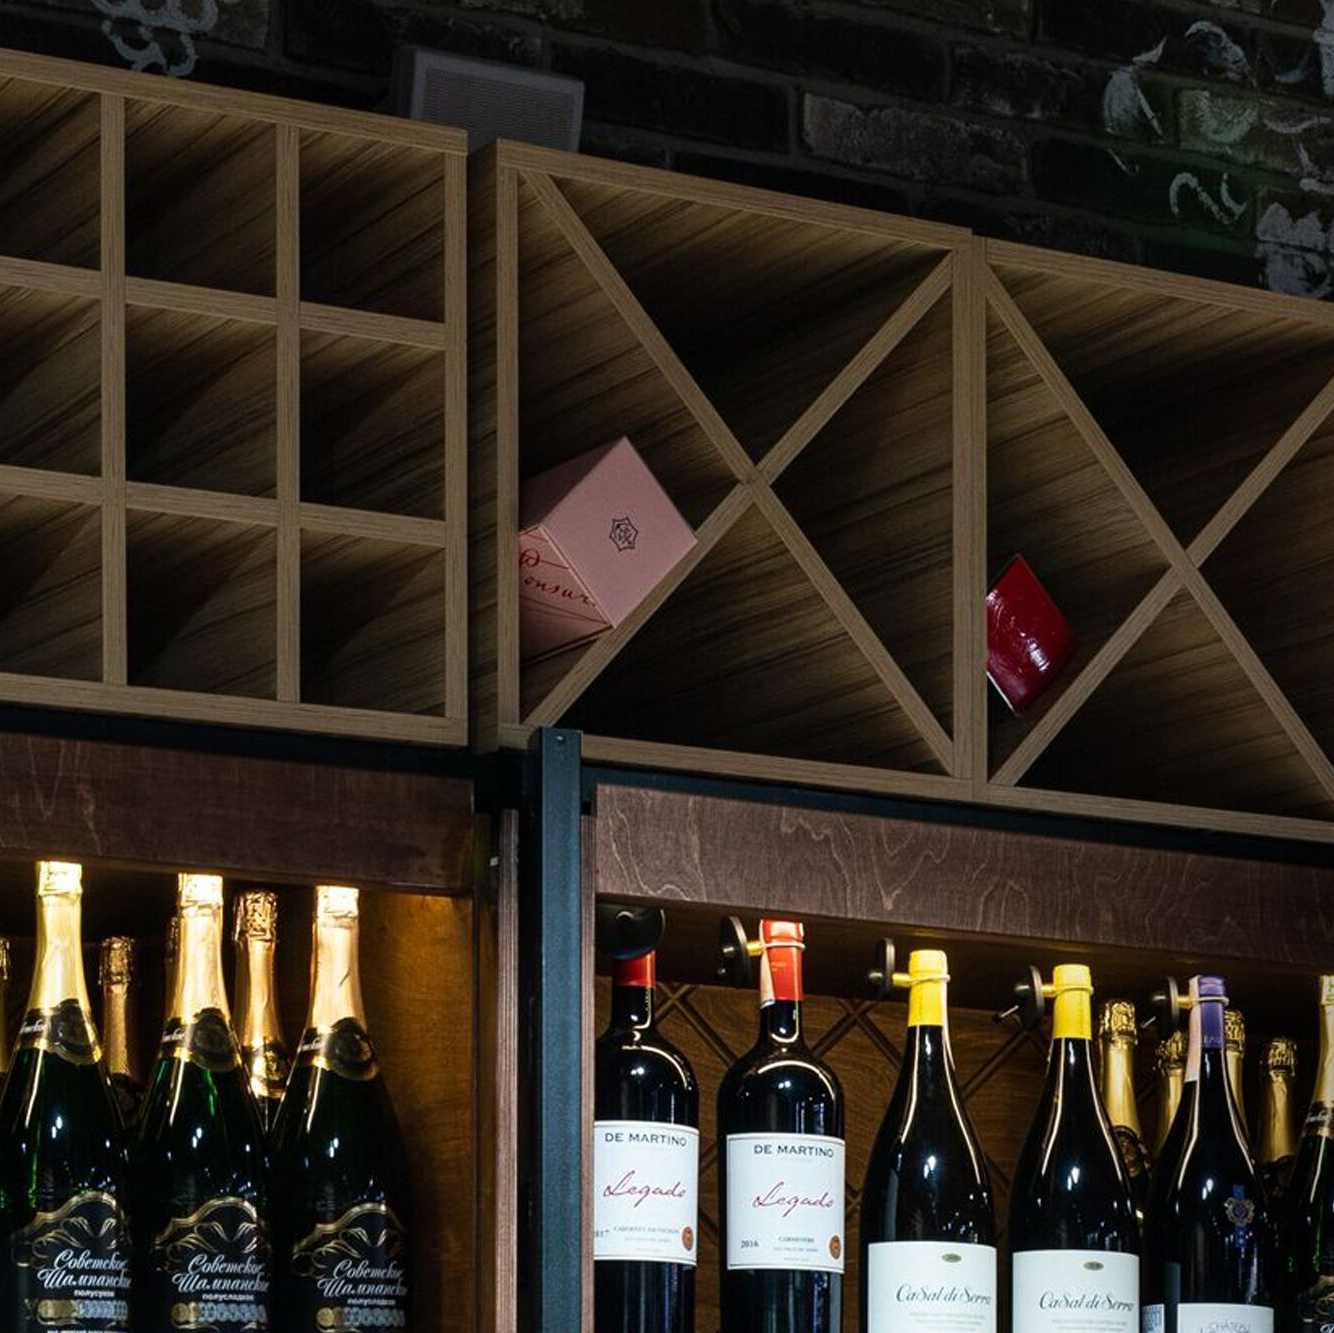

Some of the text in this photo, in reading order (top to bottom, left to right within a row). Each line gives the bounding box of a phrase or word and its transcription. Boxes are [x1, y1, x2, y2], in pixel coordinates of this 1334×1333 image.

[605, 1132, 687, 1147] DE MARTINO
[754, 1144, 834, 1158] DE MARTINO
[603, 1170, 685, 1208] Legado
[752, 1181, 833, 1217] Legado
